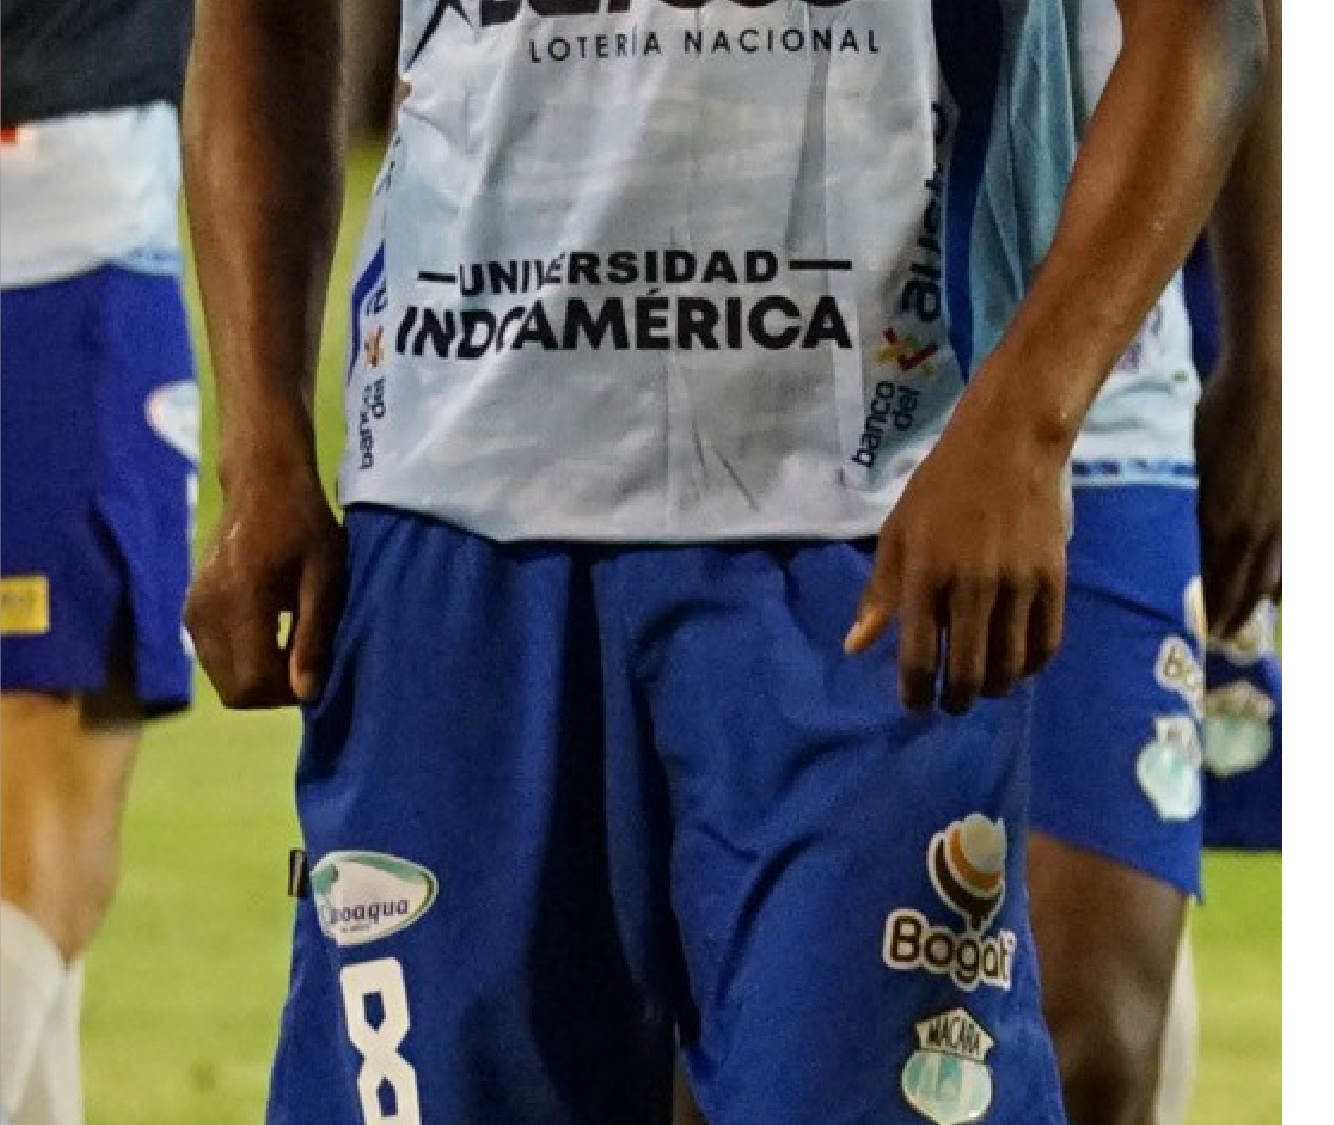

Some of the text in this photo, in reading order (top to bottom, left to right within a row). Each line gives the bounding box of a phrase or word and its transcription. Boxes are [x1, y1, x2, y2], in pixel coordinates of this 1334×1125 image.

[529, 26, 879, 63] LOTERÍA NACIONAL
[850, 379, 896, 469] banco
[892, 386, 921, 433] del
[339, 956, 422, 1125] 8
